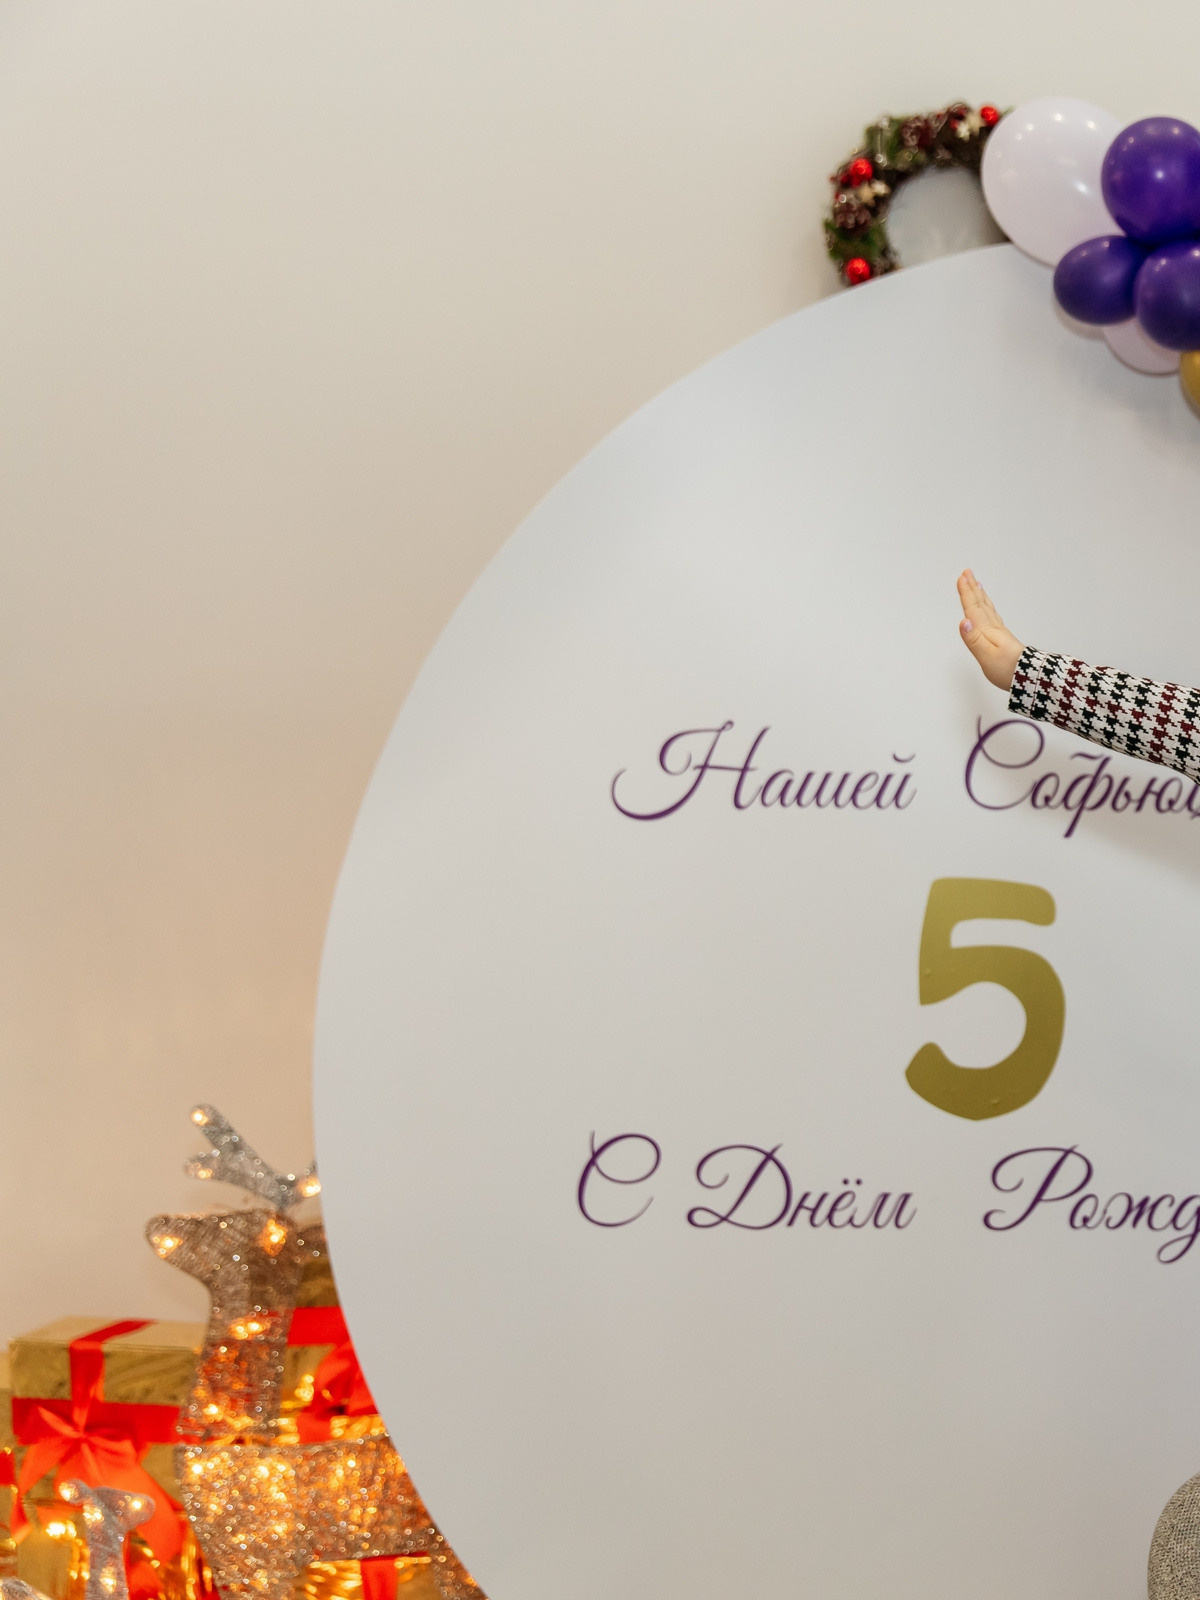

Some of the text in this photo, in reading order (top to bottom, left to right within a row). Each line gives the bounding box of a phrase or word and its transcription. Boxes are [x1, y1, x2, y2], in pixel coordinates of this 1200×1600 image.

[610, 719, 917, 821] Нашей
[904, 876, 1067, 1121] 5
[577, 1131, 662, 1228] С
[686, 1143, 918, 1231] Днём
